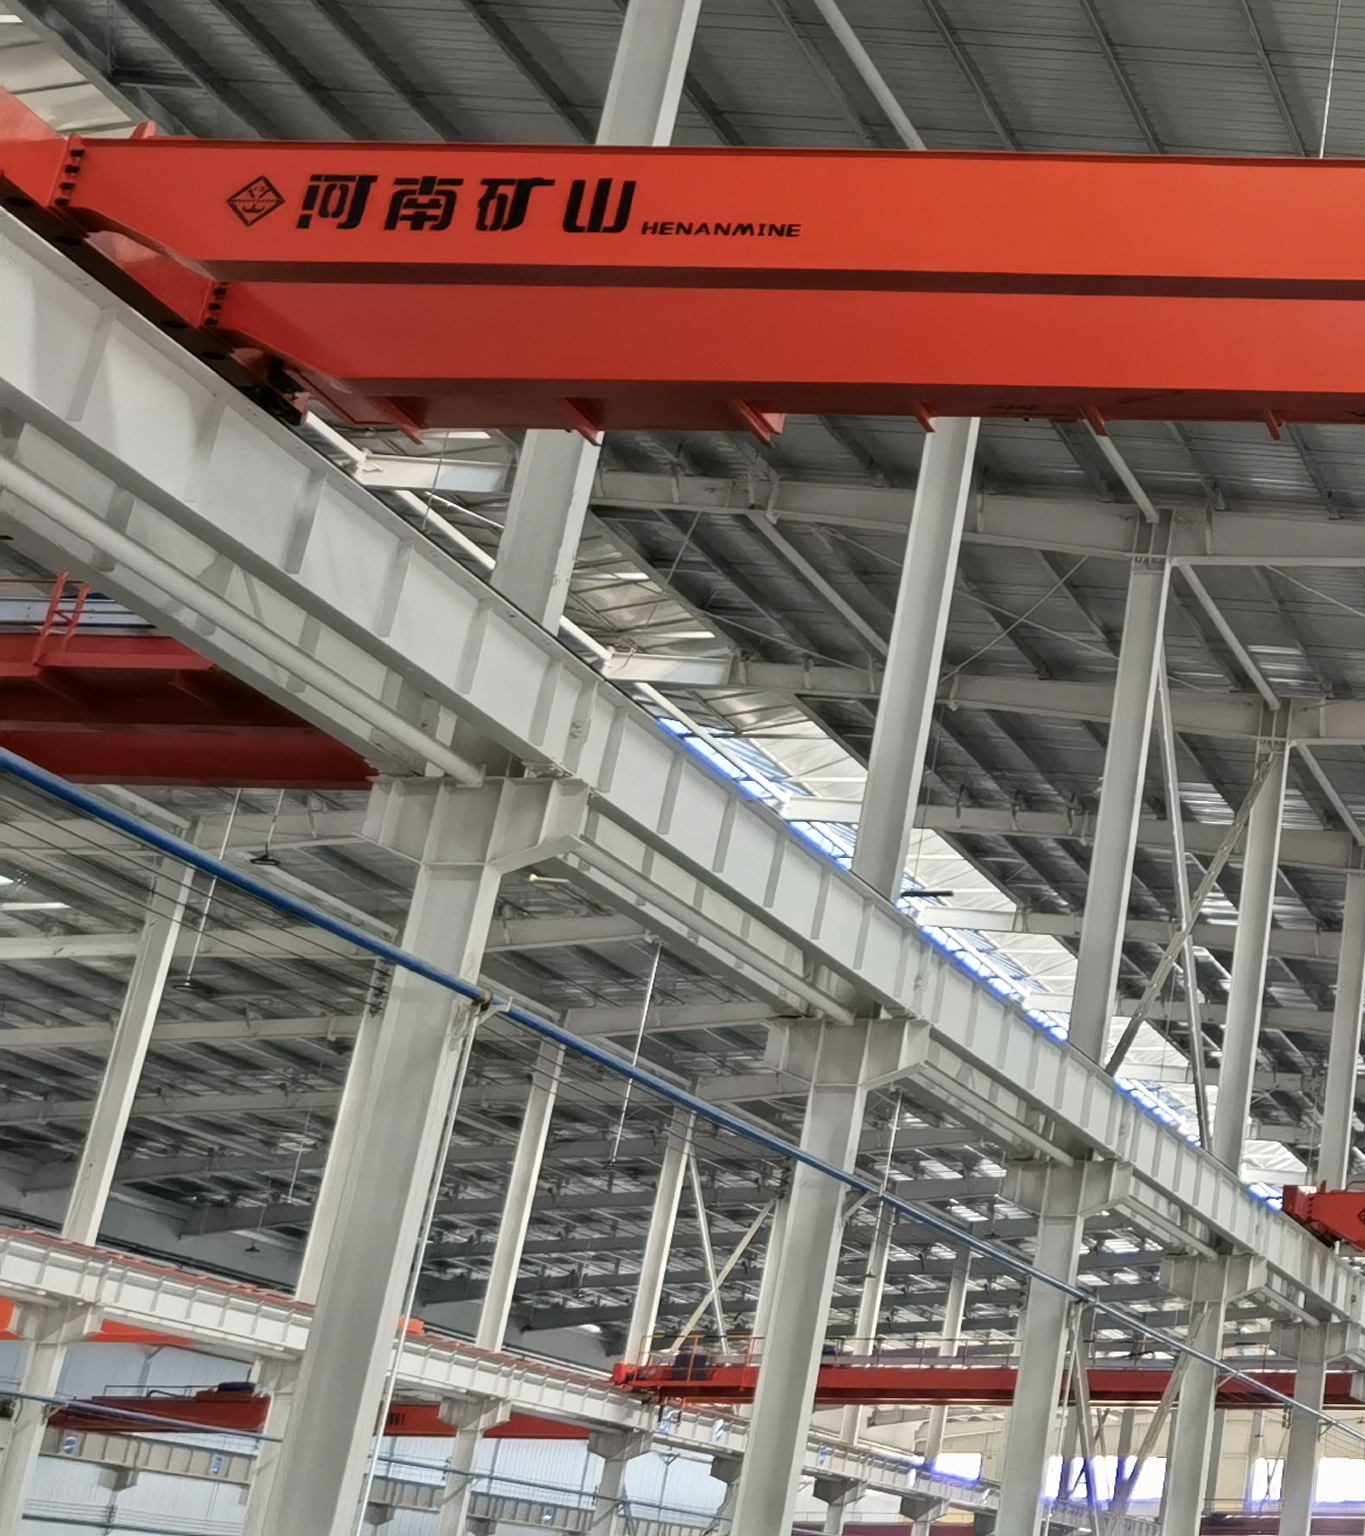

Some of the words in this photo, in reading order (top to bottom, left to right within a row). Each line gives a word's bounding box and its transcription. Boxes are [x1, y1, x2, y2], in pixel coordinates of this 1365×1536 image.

[296, 174, 637, 234] 河南矿山
[641, 221, 802, 238] HENANMINE
